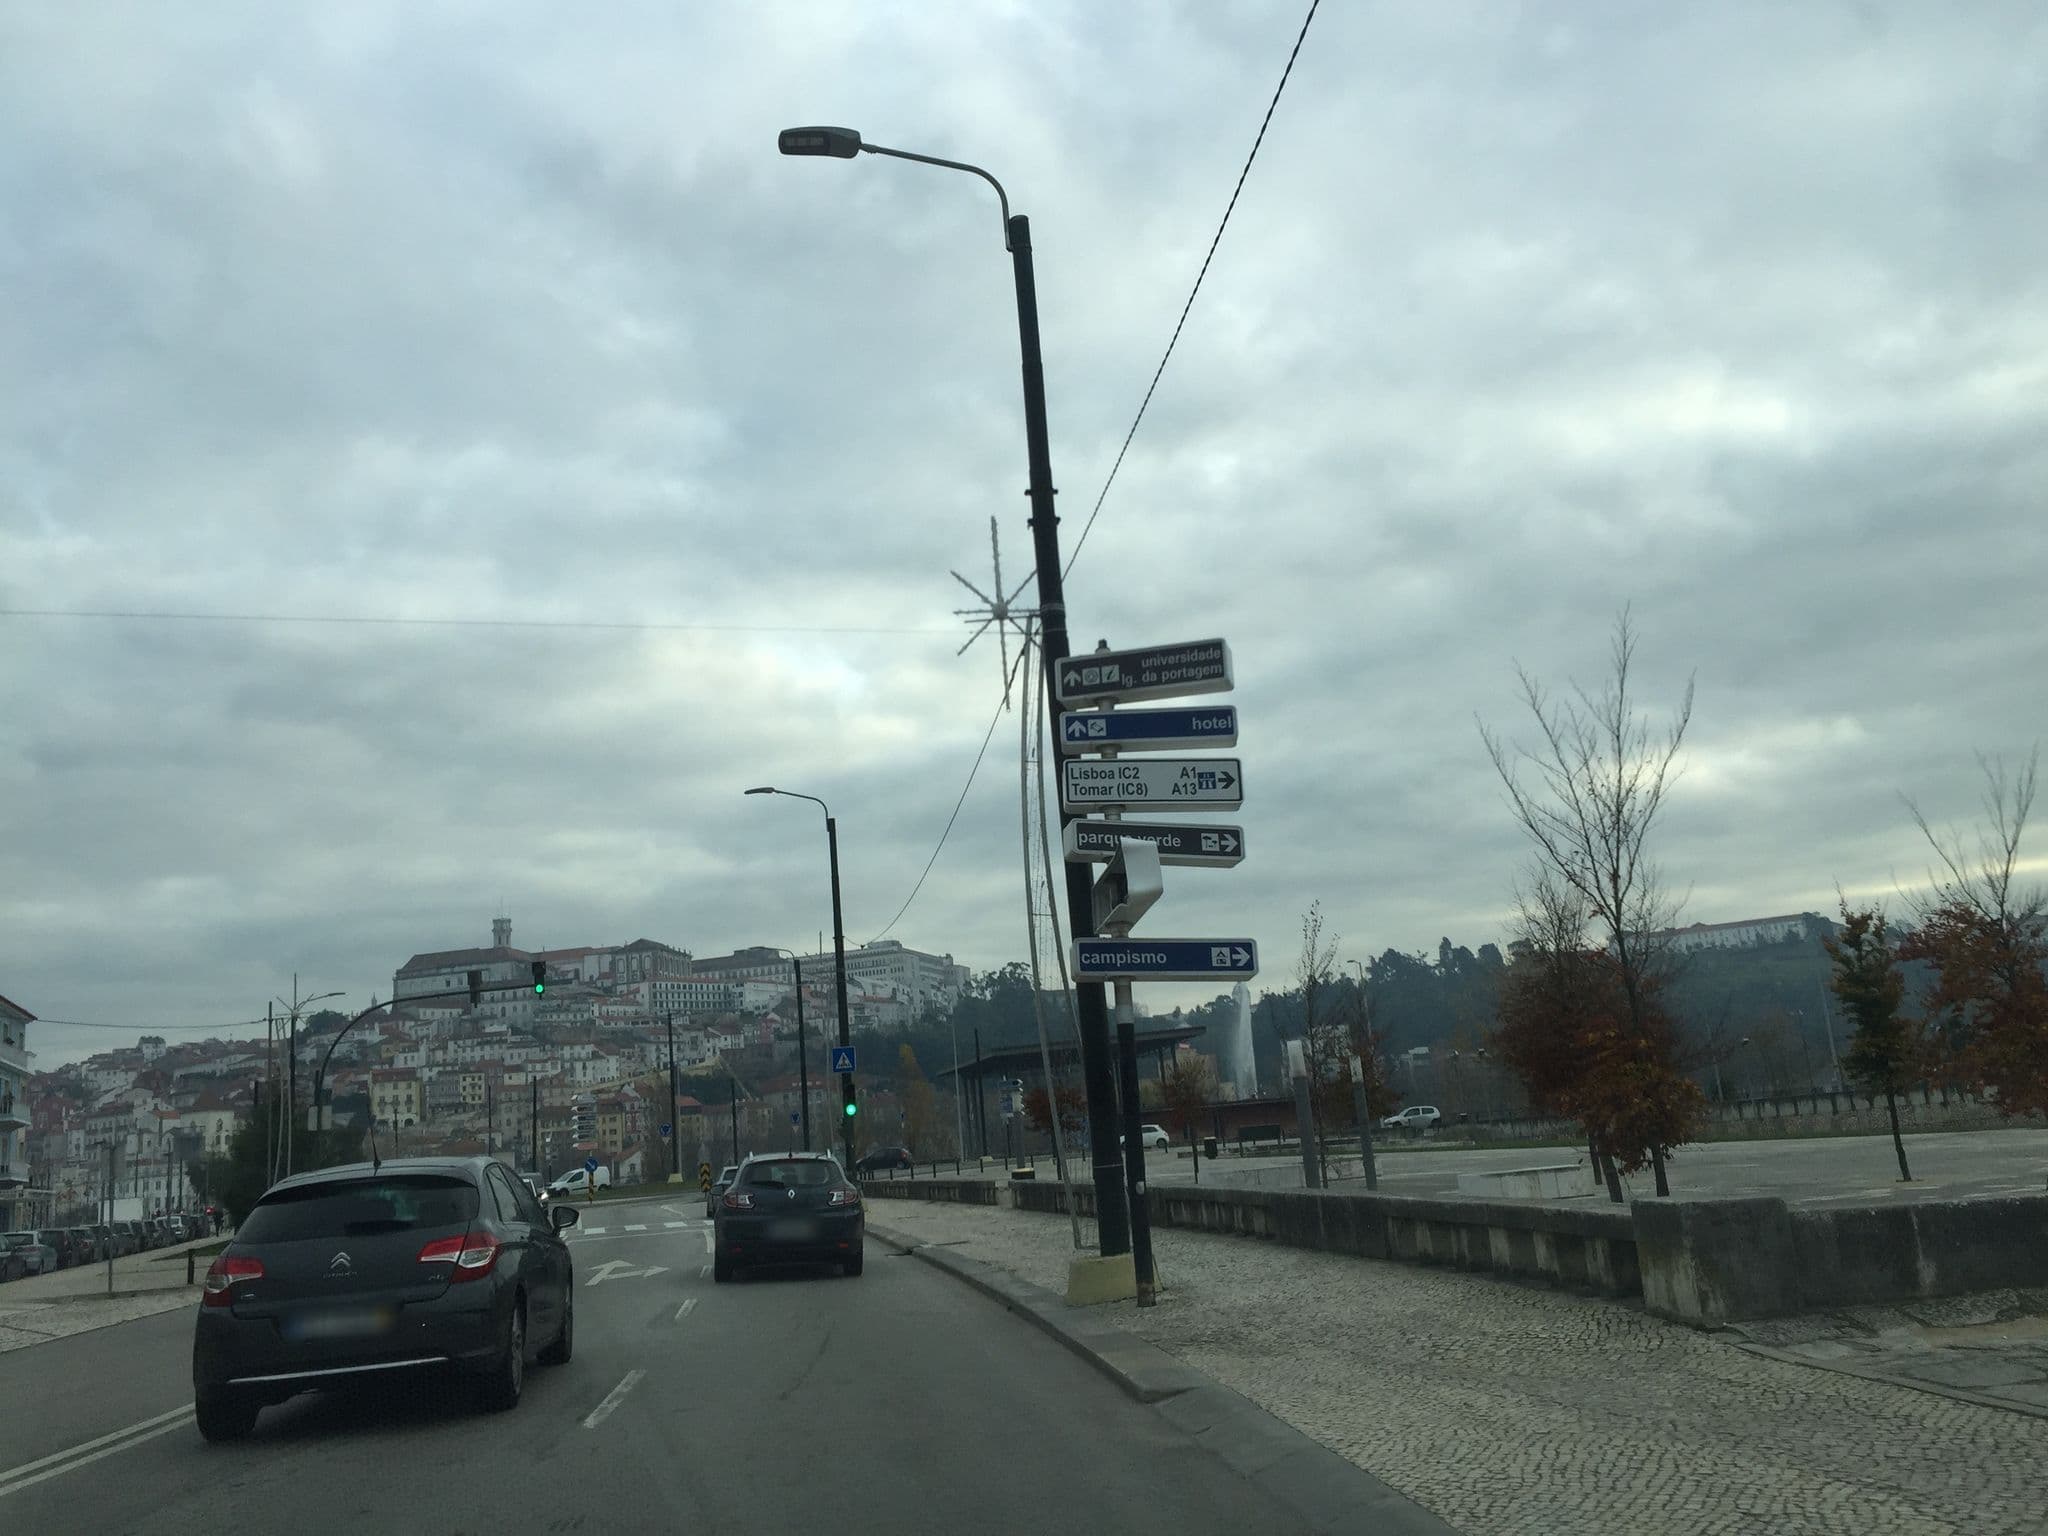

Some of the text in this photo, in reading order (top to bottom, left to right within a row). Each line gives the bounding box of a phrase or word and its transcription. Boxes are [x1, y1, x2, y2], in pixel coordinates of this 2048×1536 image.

[1141, 647, 1221, 667] universidade
[1142, 667, 1157, 682] da
[1161, 663, 1223, 683] portagem
[1192, 716, 1232, 730] hotel
[1070, 766, 1198, 780] Lisboa IC2 A1
[1072, 782, 1198, 797] Tomar (IC8) A13
[1081, 950, 1167, 967] campismo
